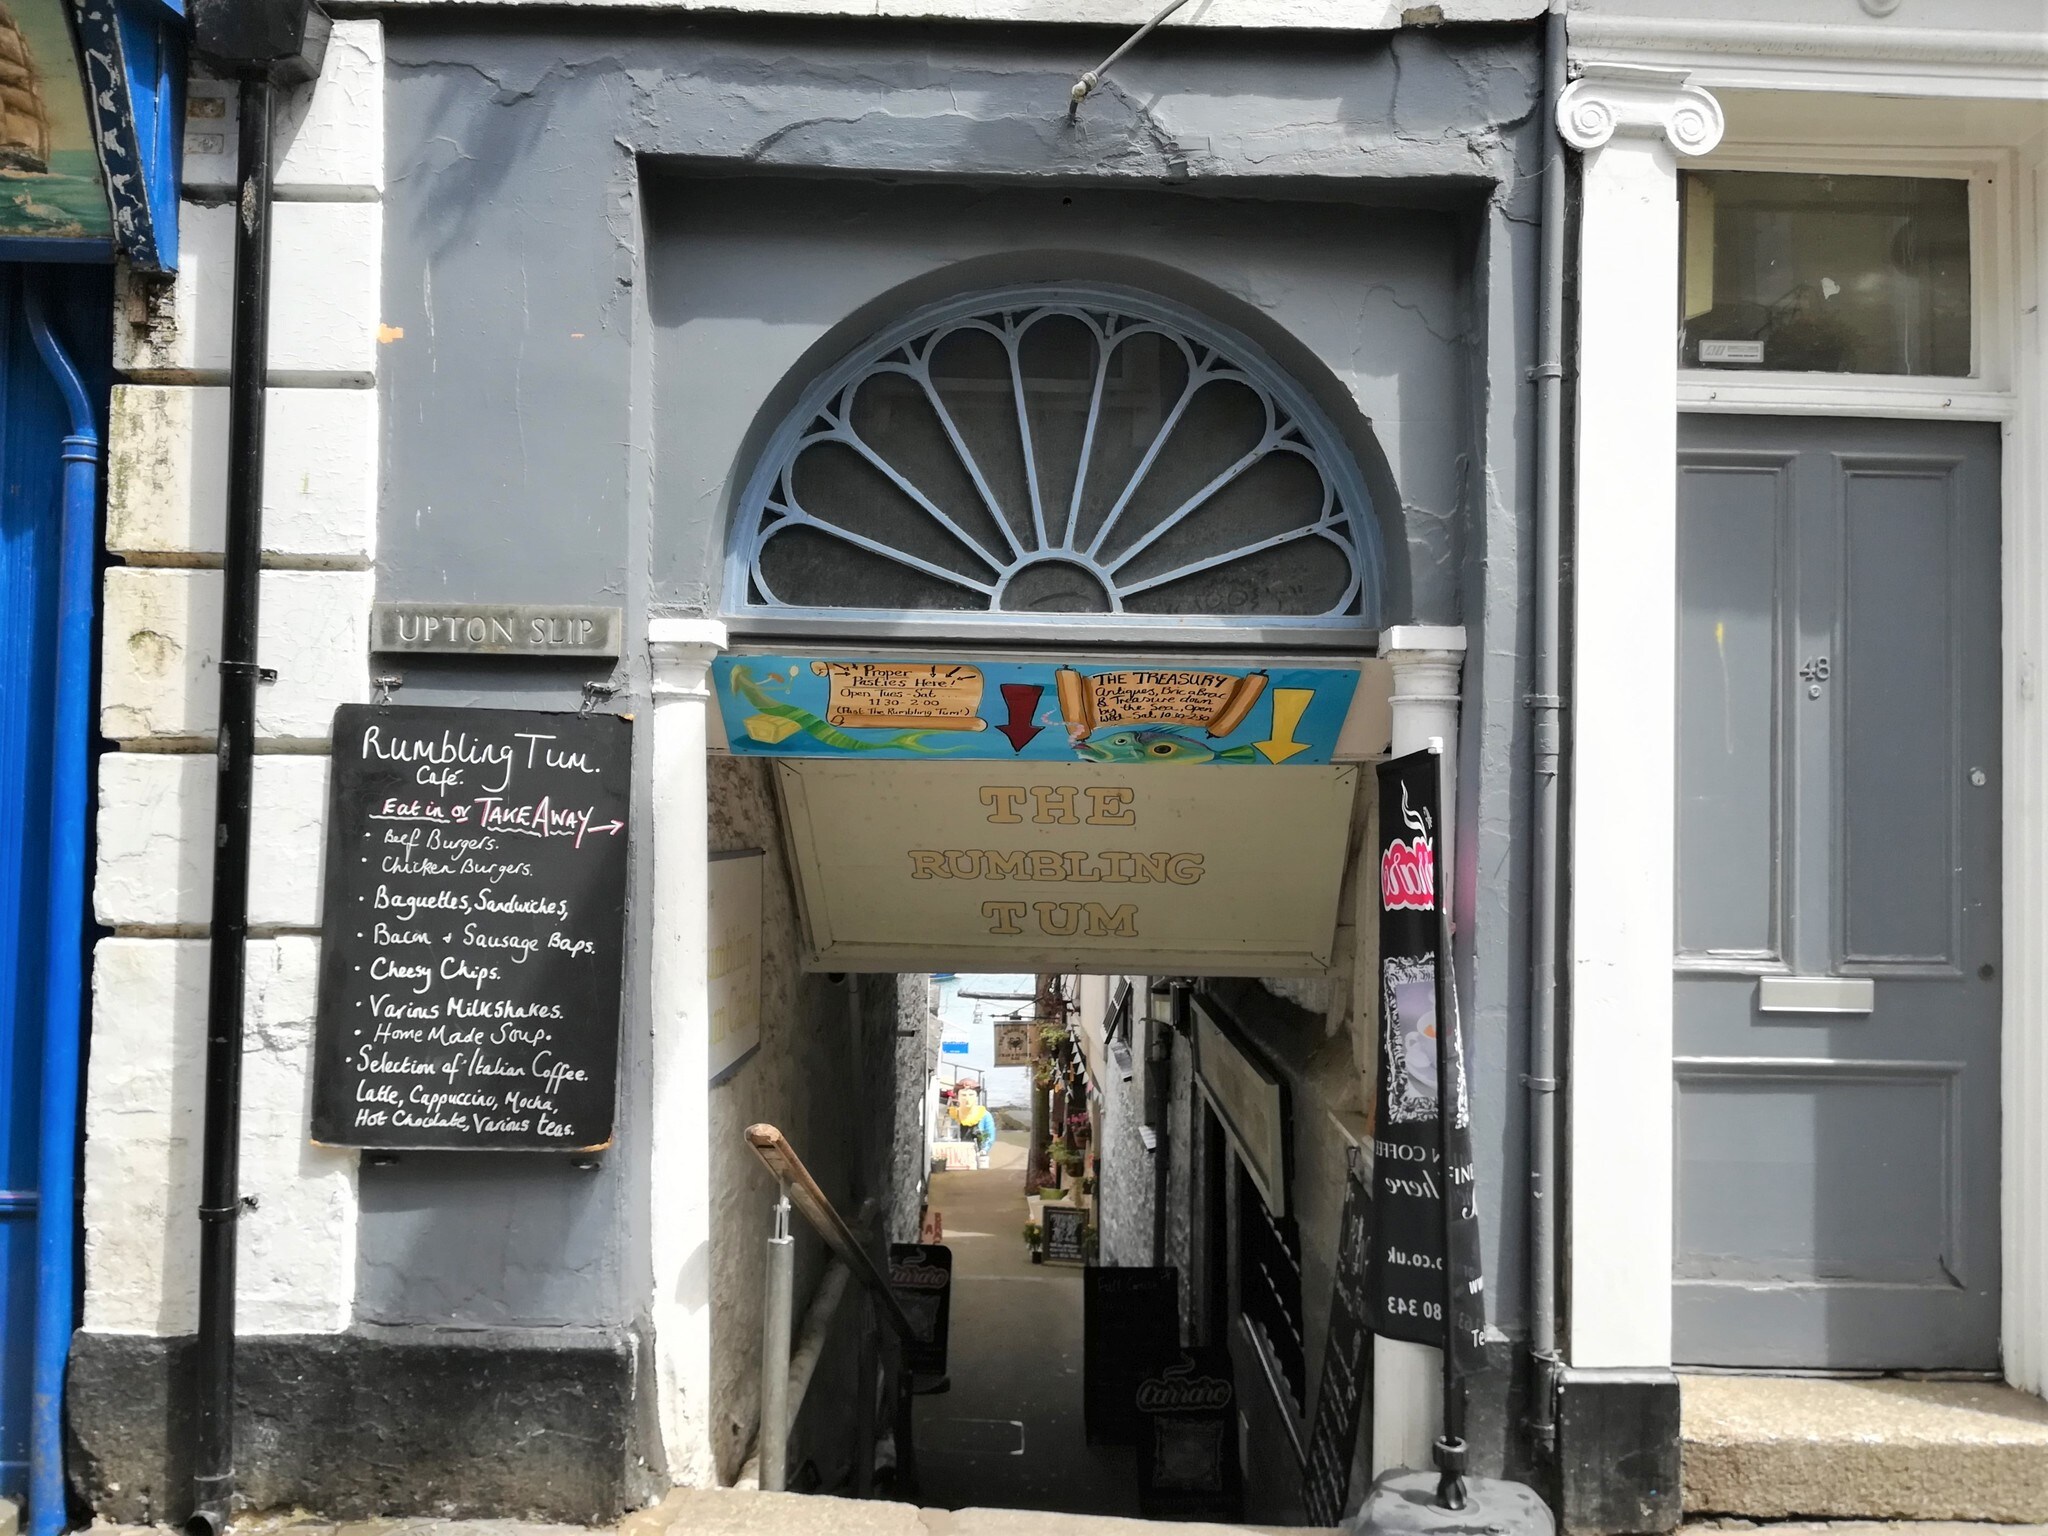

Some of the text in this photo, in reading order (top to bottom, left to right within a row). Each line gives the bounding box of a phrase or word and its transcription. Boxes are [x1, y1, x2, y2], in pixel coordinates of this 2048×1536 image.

[399, 615, 594, 645] UPTON SLIP
[853, 676, 907, 688] Pasties
[864, 665, 912, 680] Proper
[1093, 671, 1229, 688] THE TREASURY
[1799, 656, 1829, 682] 48
[840, 688, 871, 698] Open
[874, 689, 903, 698] Tues
[913, 688, 937, 698] Sat
[1109, 694, 1176, 705] Treasure
[1179, 694, 1214, 705] down
[1160, 686, 1187, 696] Bric
[1196, 687, 1228, 700] Brac
[1120, 703, 1146, 712] the
[1184, 704, 1215, 714] Open
[362, 725, 514, 793] Rumbling
[382, 797, 419, 816] Eat
[426, 803, 445, 818] in
[451, 805, 472, 818] or
[978, 785, 1137, 826] THE
[384, 828, 500, 863] Beef Burgers.
[381, 855, 534, 884] Chicken Burgers.
[906, 849, 1206, 886] RUMBLING
[373, 884, 569, 922] Baguettes, Sandwiches,
[980, 900, 1140, 938] TUM
[373, 922, 432, 946] Bacon
[463, 923, 540, 964] Sausage
[547, 931, 596, 959] Baps.
[370, 956, 501, 995] Cheesy Chips.
[369, 993, 440, 1020] Various
[373, 1021, 553, 1047] Home Made Soup.
[356, 1043, 590, 1096] Selection of Italian Coffee.
[355, 1078, 559, 1116] Latte, Cappuccino, Mocha,
[354, 1108, 389, 1129] Hot
[472, 1113, 531, 1134] Various
[536, 1112, 576, 1138] teas.
